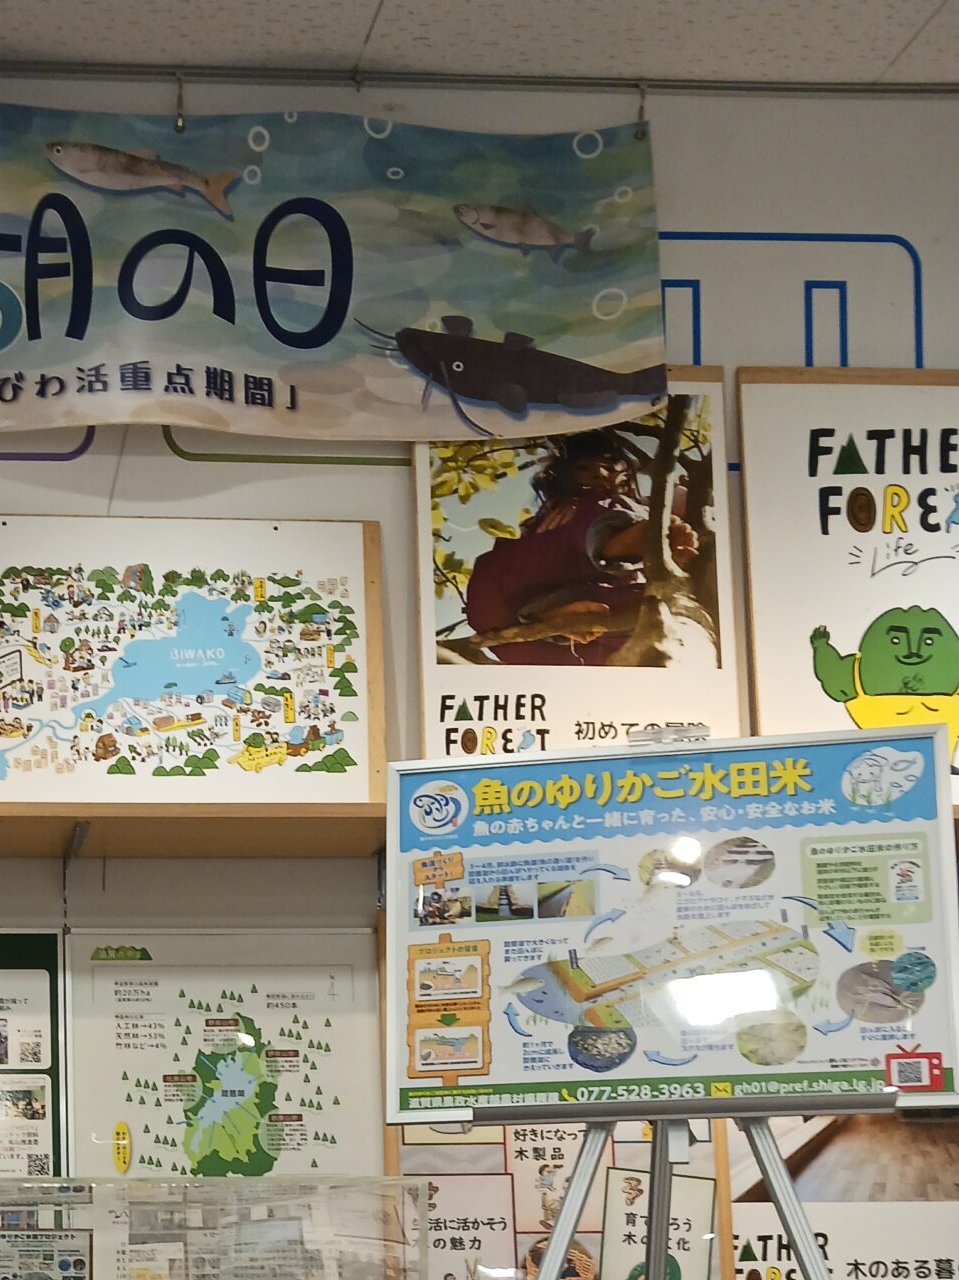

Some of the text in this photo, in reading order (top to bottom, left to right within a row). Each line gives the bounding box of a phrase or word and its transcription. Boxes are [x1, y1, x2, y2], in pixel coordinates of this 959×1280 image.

[170, 648, 226, 660] BIWAKO
[439, 694, 547, 722] FATHER
[471, 757, 815, 816] 魚のゆりかご水田米
[577, 1083, 705, 1101] 077-528-3963
[514, 1147, 565, 1161] 木製品
[412, 1237, 482, 1251] の魅力
[732, 1232, 830, 1262] ATHR
[845, 1258, 959, 1280] 木のある暮
